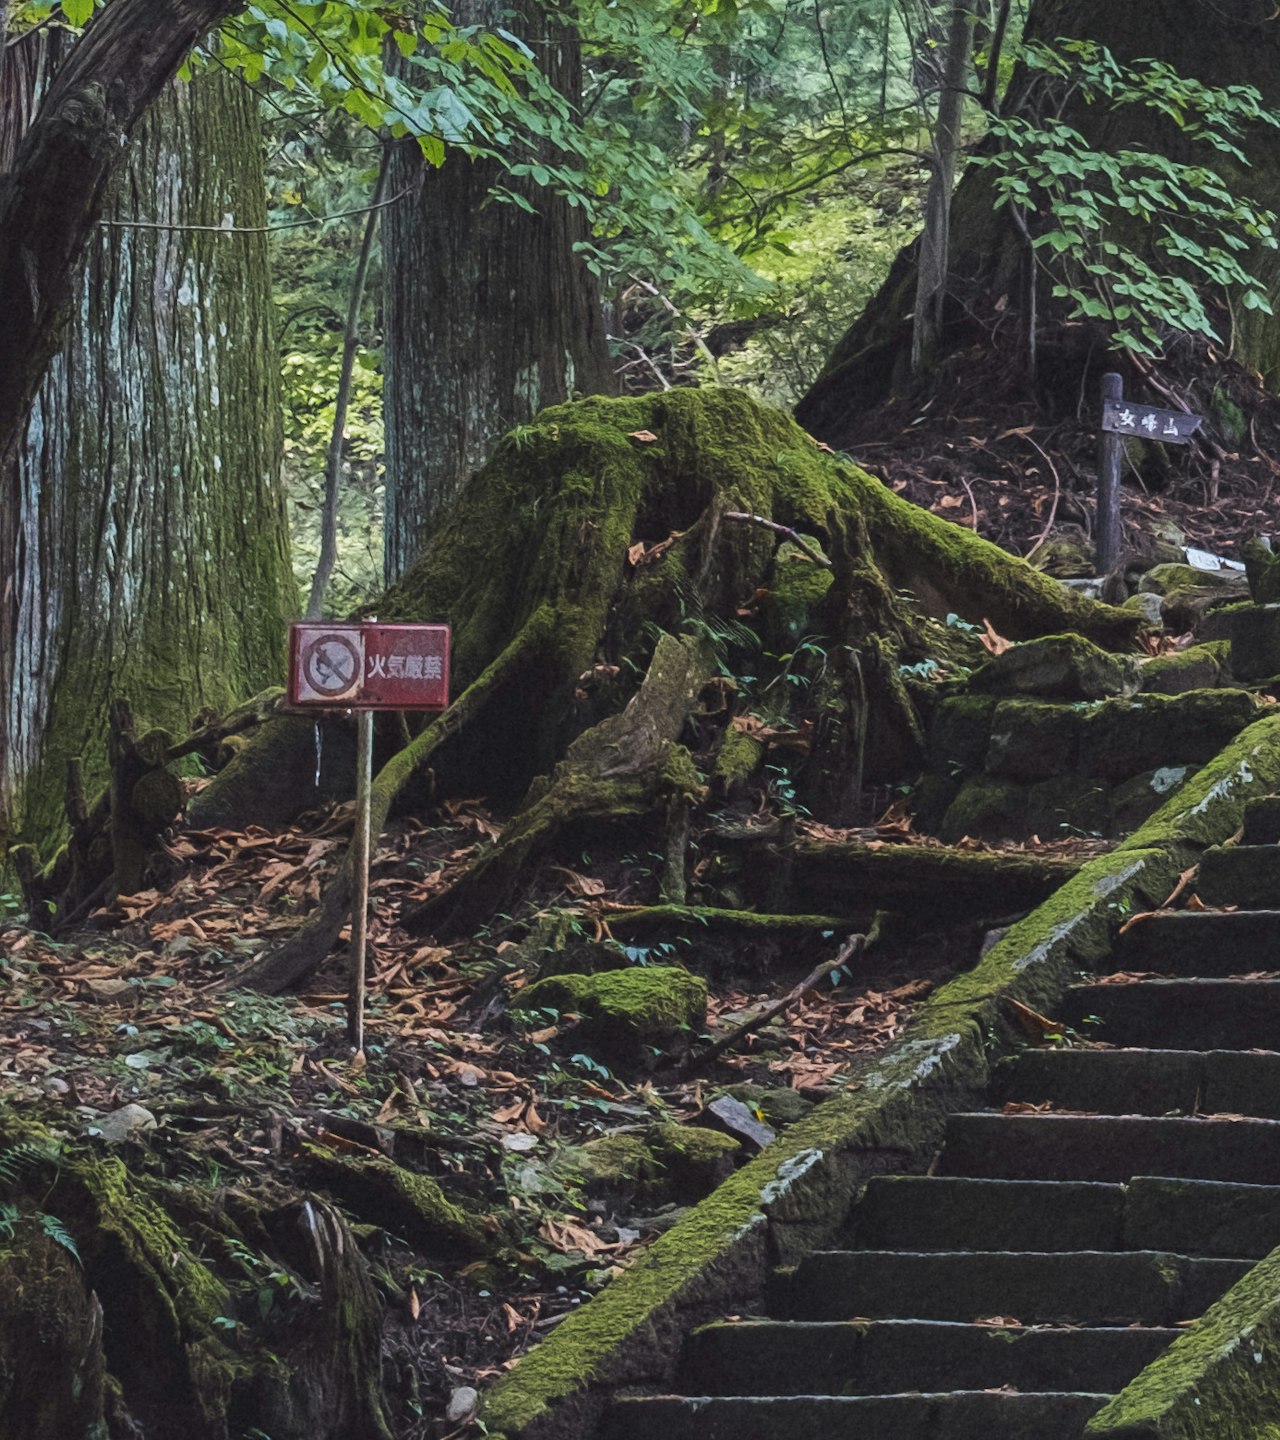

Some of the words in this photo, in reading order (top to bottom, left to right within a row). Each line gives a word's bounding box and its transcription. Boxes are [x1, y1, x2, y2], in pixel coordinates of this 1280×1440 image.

[1118, 408, 1179, 436] 女峰山
[367, 653, 443, 680] 火気厳禁
